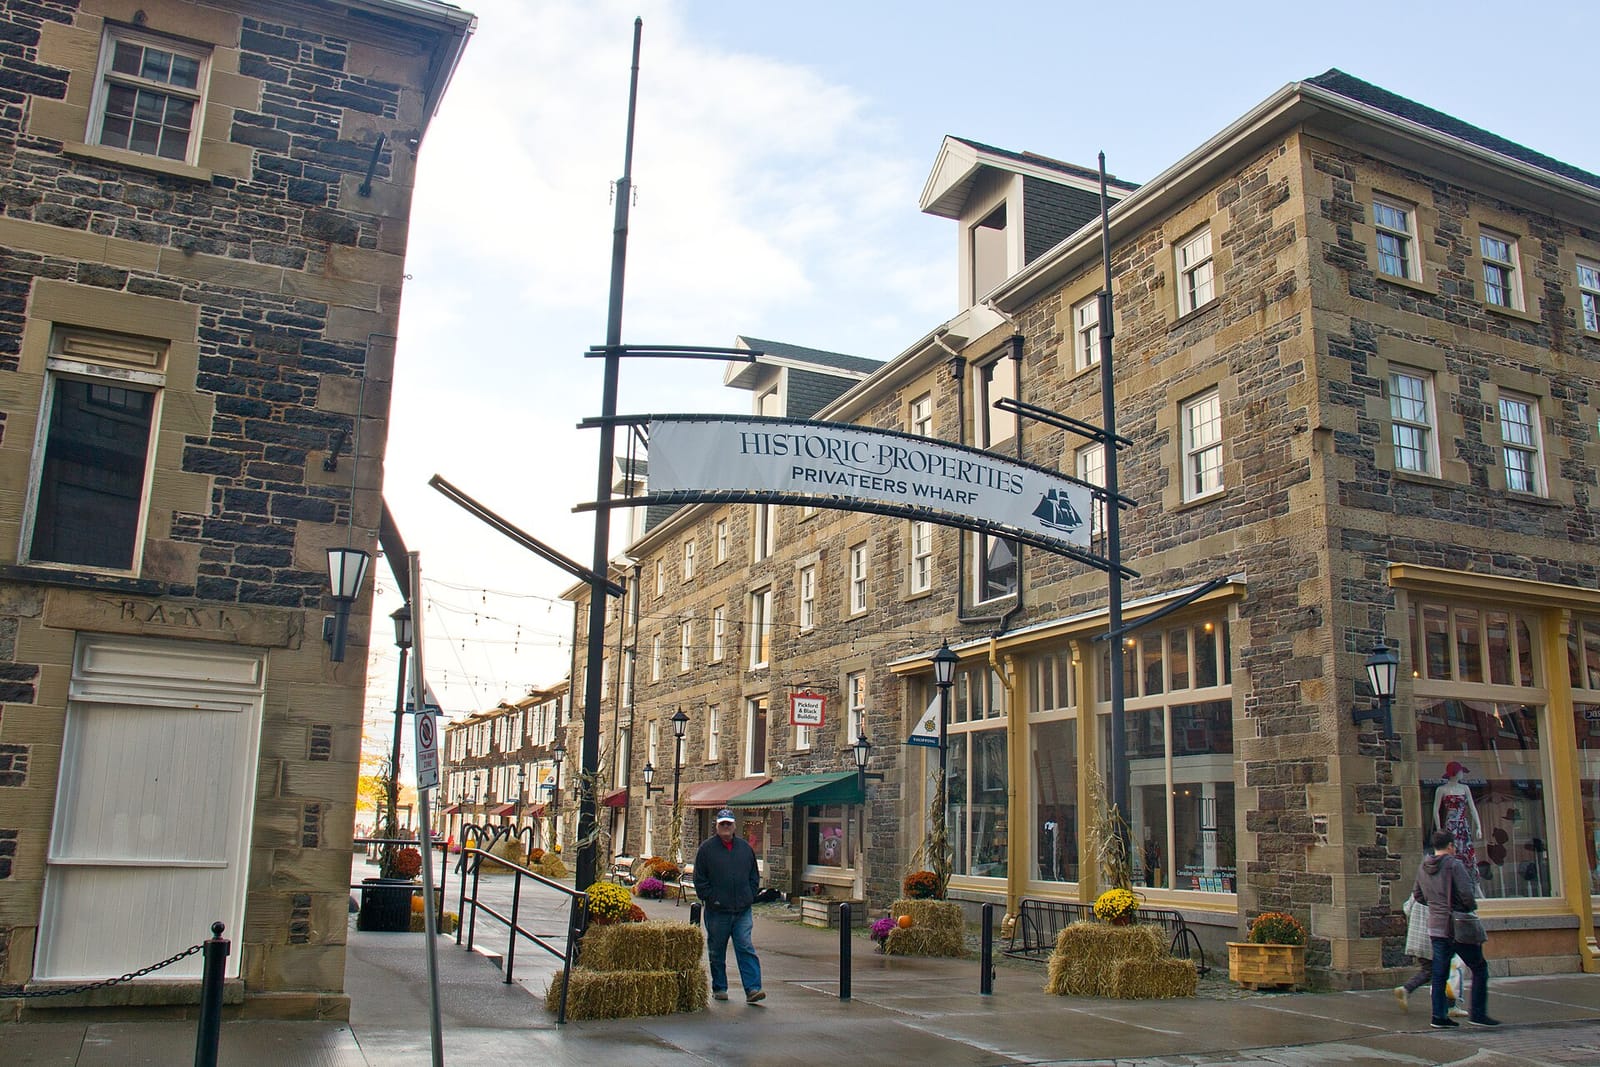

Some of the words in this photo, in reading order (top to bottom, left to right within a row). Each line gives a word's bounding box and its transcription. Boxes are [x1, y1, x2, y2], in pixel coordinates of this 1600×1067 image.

[739, 431, 870, 464] HISTORIC
[877, 443, 1024, 495] PROPERTIES
[791, 466, 908, 495] PRIVATEERS
[913, 484, 979, 505] WHARF
